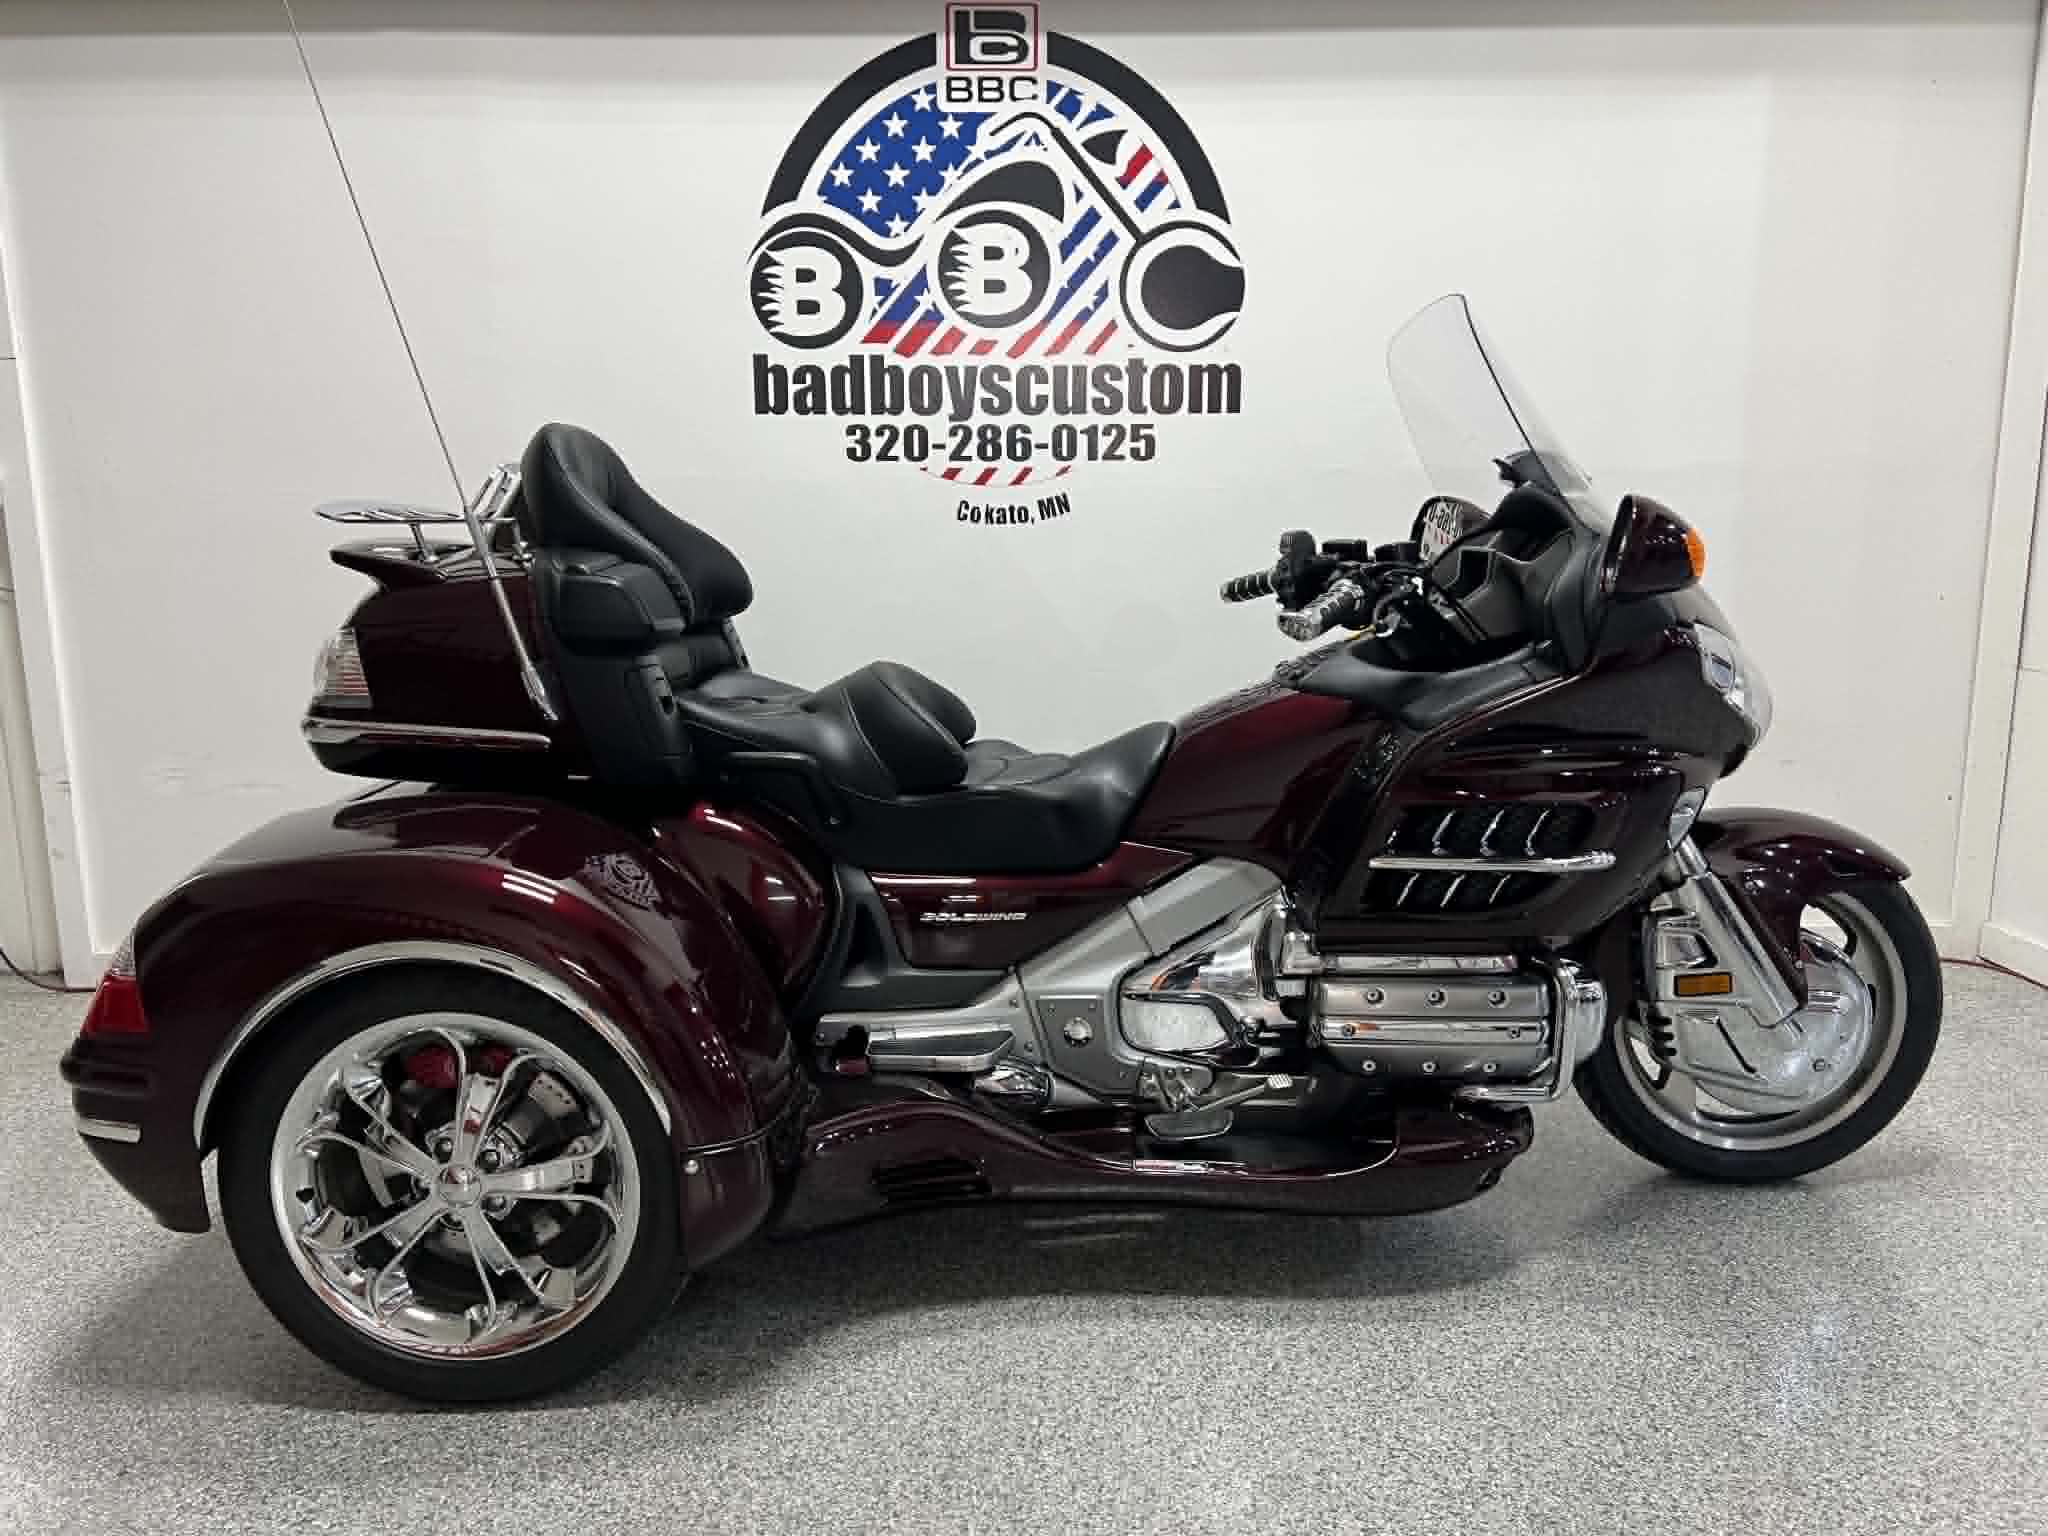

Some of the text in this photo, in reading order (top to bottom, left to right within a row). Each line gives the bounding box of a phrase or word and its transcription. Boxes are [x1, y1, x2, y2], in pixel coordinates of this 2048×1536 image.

[946, 76, 1039, 103] BBC
[753, 354, 1242, 422] badboyscustom
[845, 423, 1156, 463] 320-286-0125
[957, 492, 1071, 525] Cokato, MN
